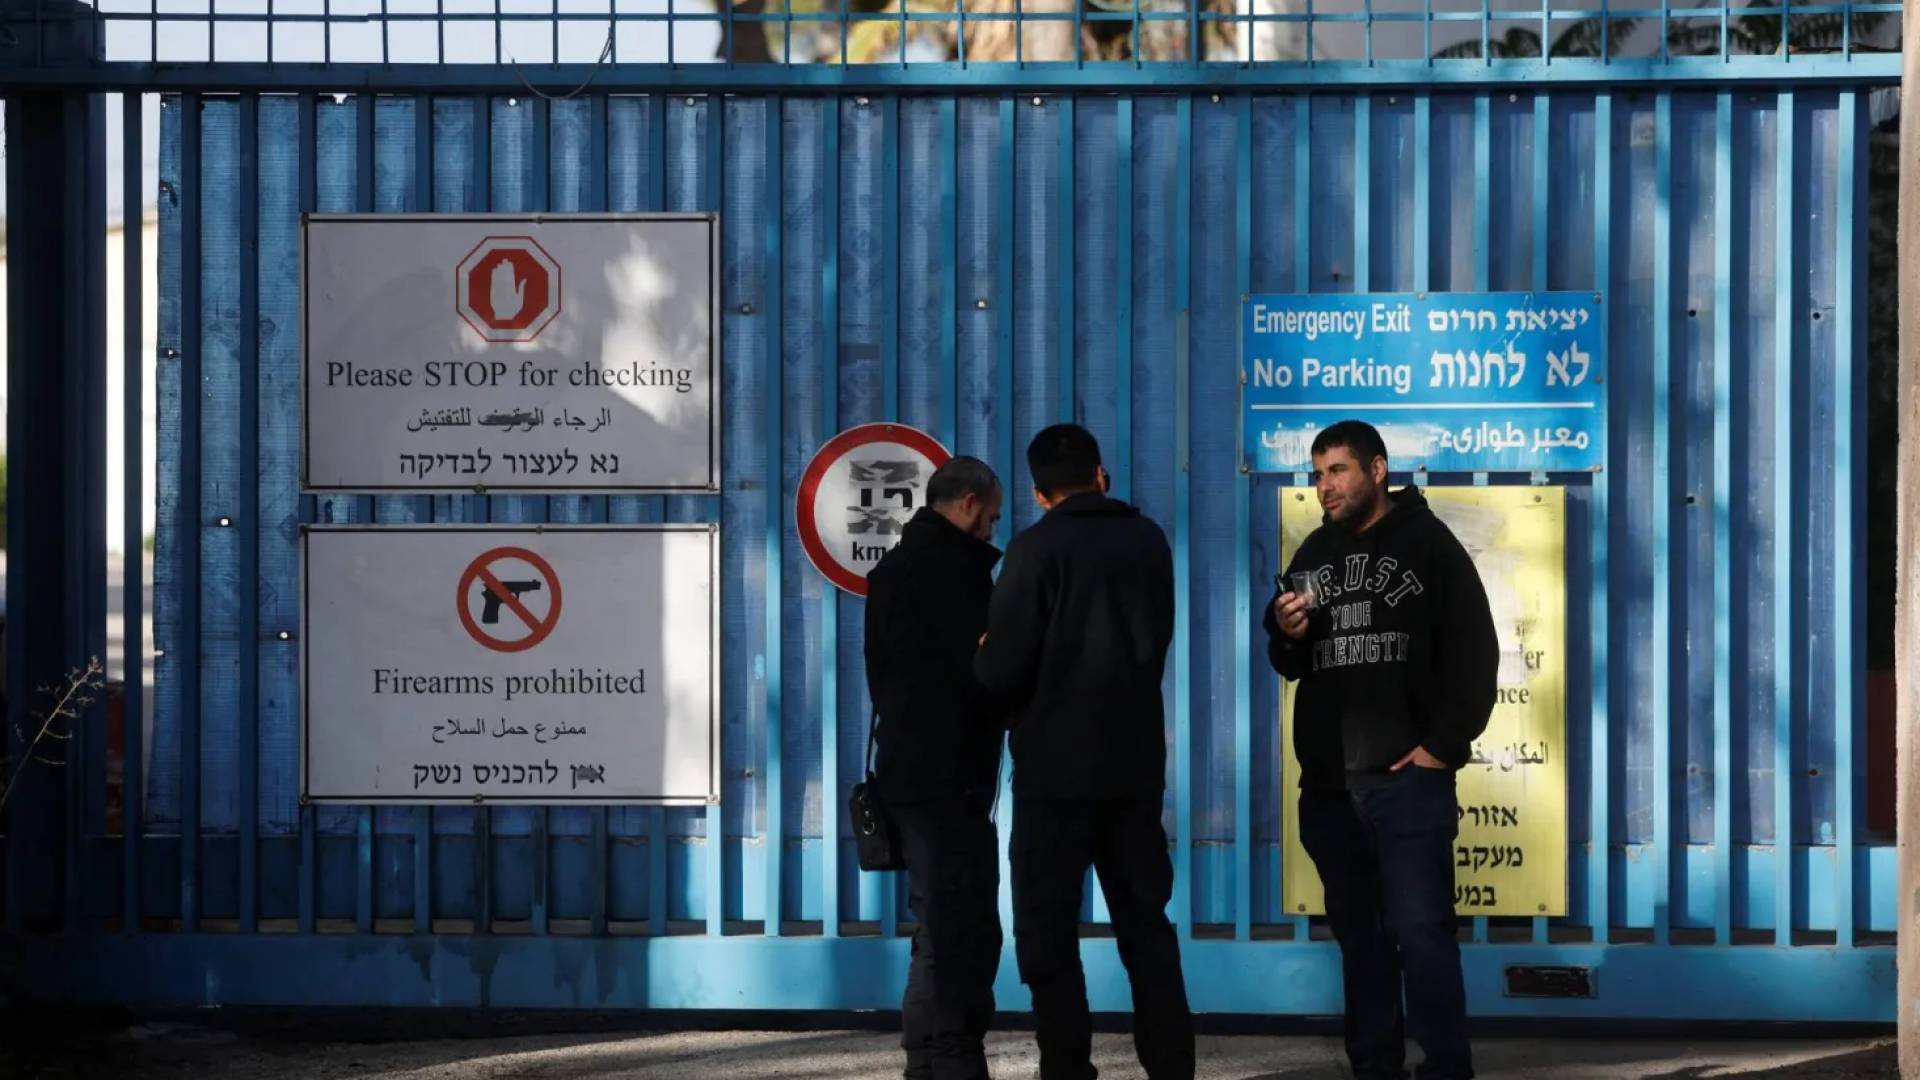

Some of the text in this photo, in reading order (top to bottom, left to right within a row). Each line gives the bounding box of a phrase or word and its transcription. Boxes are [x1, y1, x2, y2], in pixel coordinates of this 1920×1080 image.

[1253, 303, 1411, 341] Emergency Exit
[1427, 308, 1590, 332] יציאת חרום
[327, 361, 693, 393] Please STOP for checking
[1253, 357, 1411, 394] No Parking
[1429, 341, 1590, 388] לא לחנות
[406, 407, 472, 433] للتفتيش
[552, 407, 611, 433] الرجاء
[1530, 427, 1589, 454] معبر
[400, 447, 619, 480] נא לעצור לבדיקה
[852, 542, 886, 561] km
[1316, 553, 1424, 608] RUST
[1330, 600, 1373, 631] YOUR
[1312, 632, 1410, 671] TRENGTH
[373, 668, 646, 701] Firearms prohibited
[431, 717, 587, 743] ممنوع حمل السلاح
[413, 763, 462, 789] נשק
[472, 758, 559, 785] להכניס
[1457, 845, 1523, 873] מעקב
[1455, 884, 1497, 906] במע
